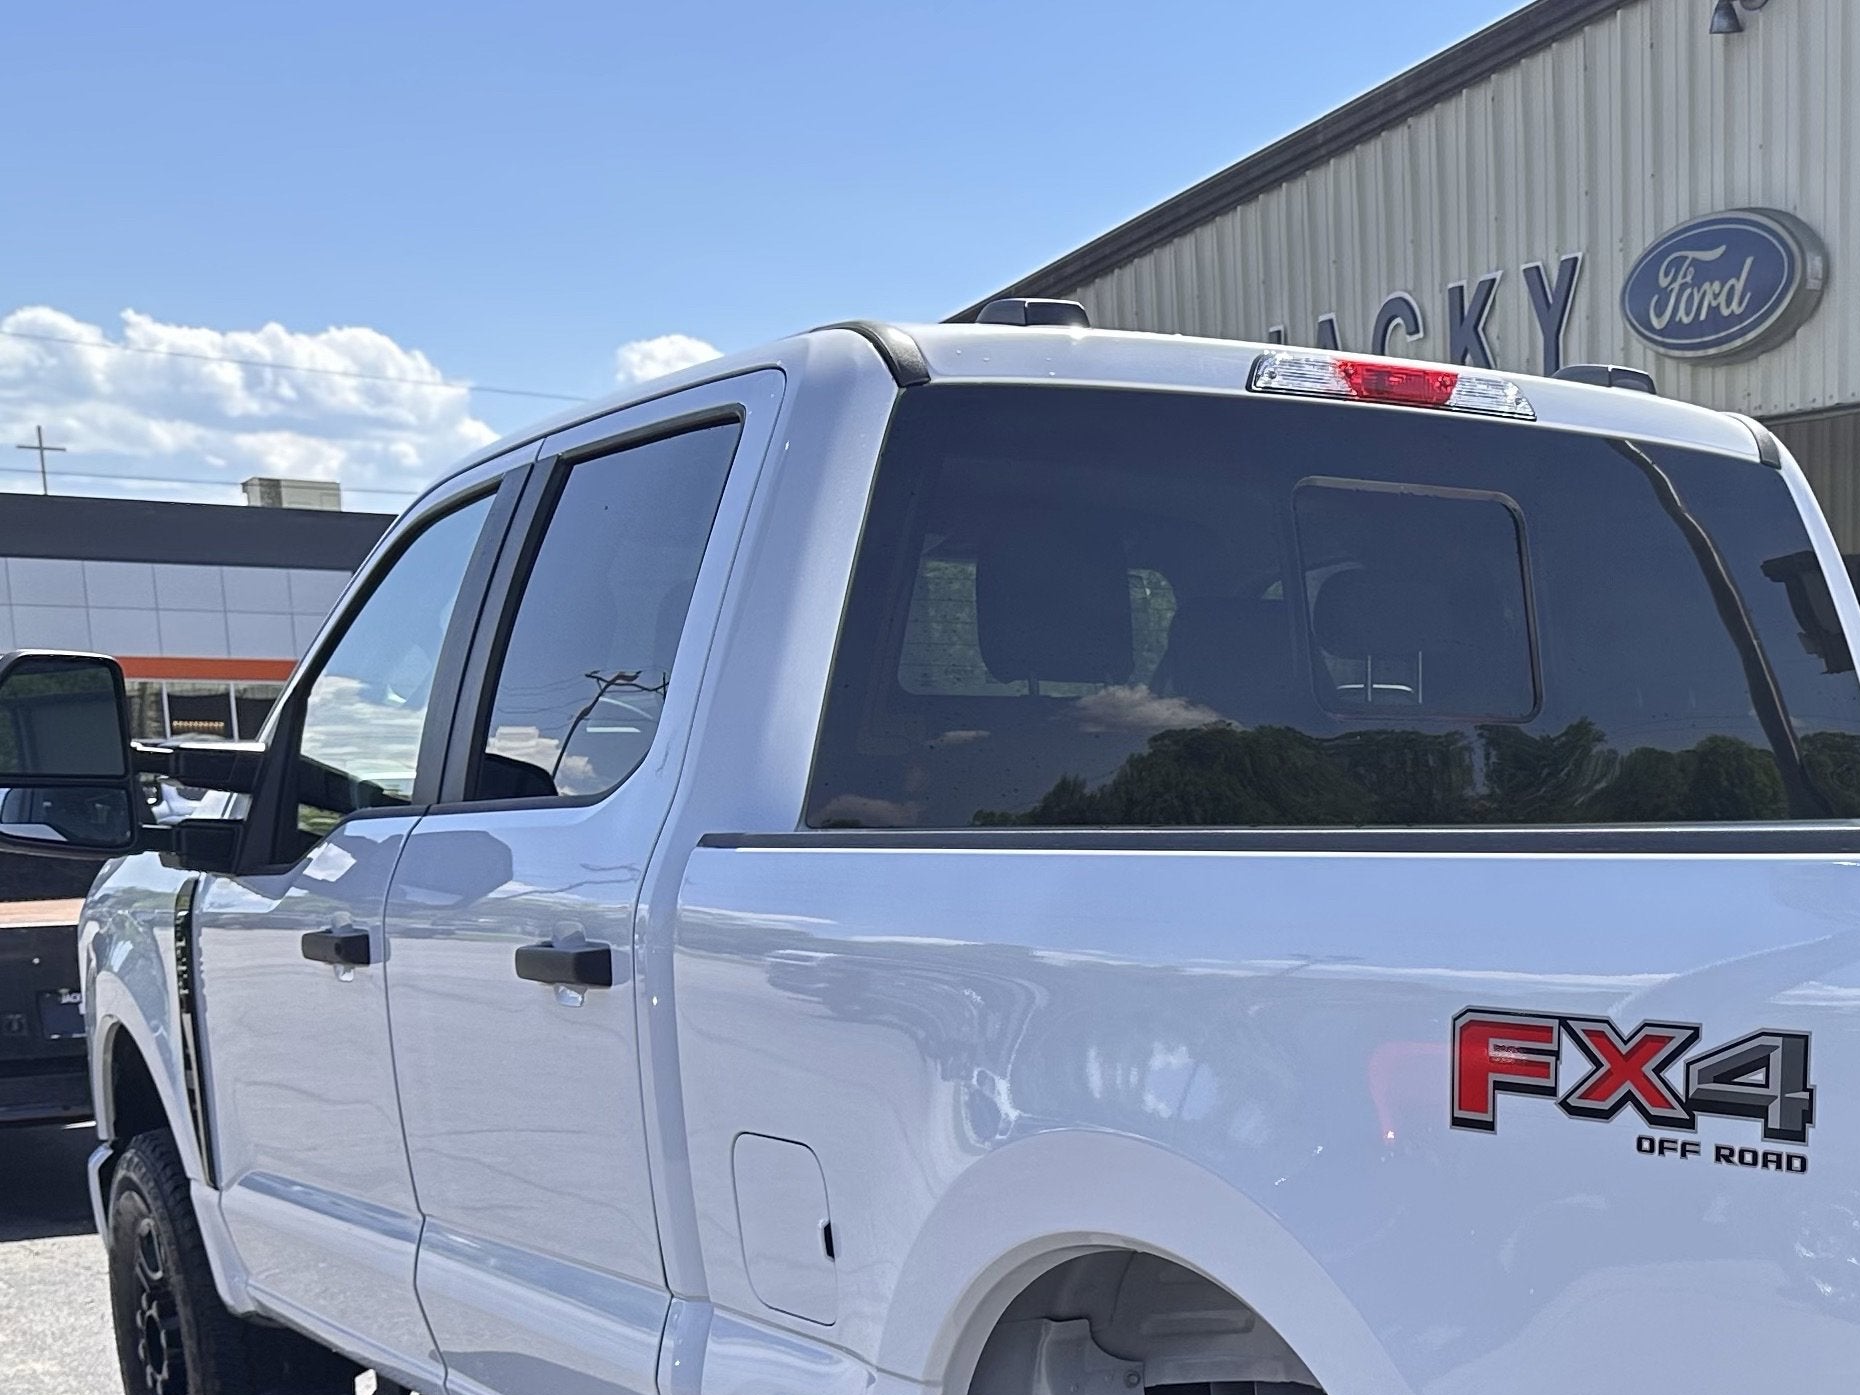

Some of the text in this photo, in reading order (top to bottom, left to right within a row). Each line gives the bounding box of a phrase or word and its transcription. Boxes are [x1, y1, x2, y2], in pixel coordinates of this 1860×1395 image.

[1649, 244, 1754, 330] Ford
[1449, 1004, 1817, 1146] FX4
[1636, 1135, 1809, 1174] OFF ROAD
